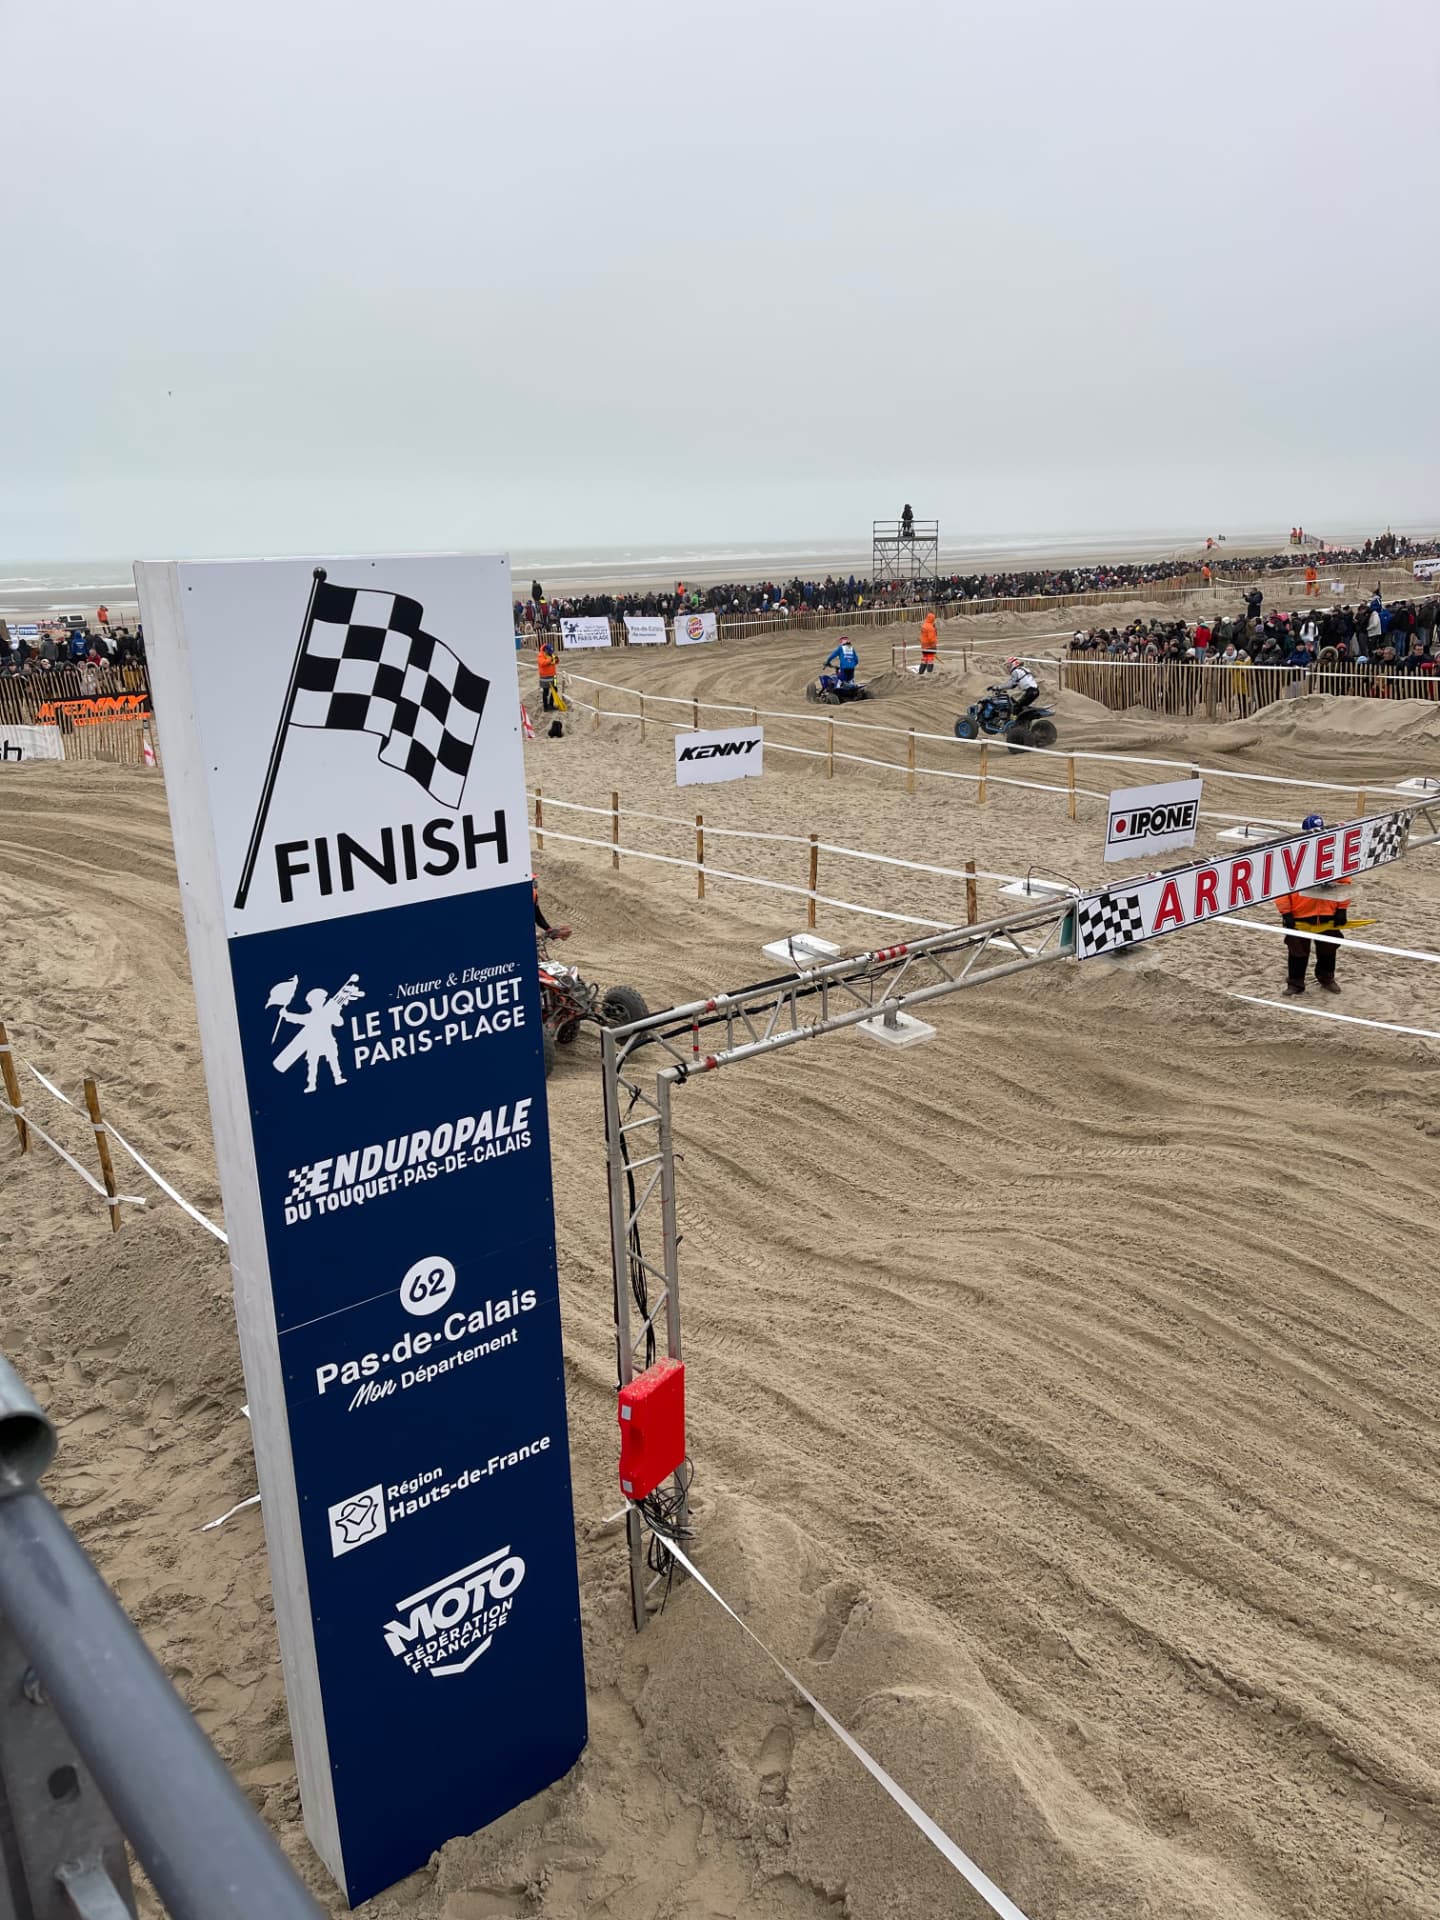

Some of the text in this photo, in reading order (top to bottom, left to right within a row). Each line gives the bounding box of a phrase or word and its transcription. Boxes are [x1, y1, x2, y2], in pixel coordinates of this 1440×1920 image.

[0, 739, 23, 762] h
[678, 738, 761, 762] KENNY
[1129, 803, 1194, 837] IPONE
[275, 809, 509, 903] FINISH
[1151, 826, 1363, 933] ARRIVEE
[351, 976, 523, 1042] LE TOUQUET
[396, 961, 516, 999] Nature & Elegance
[354, 1005, 526, 1070] PARIS-PLAGE
[310, 1097, 533, 1198] ENDUROPALE
[284, 1200, 312, 1226] DU
[408, 1267, 447, 1303] 62
[347, 1327, 519, 1412] Mon Département
[387, 1466, 443, 1501] Région
[388, 1435, 551, 1524] Hauts-de-France
[382, 1556, 526, 1657] MOTO
[403, 1597, 513, 1667] FÉDÉRATION
[411, 1612, 508, 1675] FRANÇAISE
